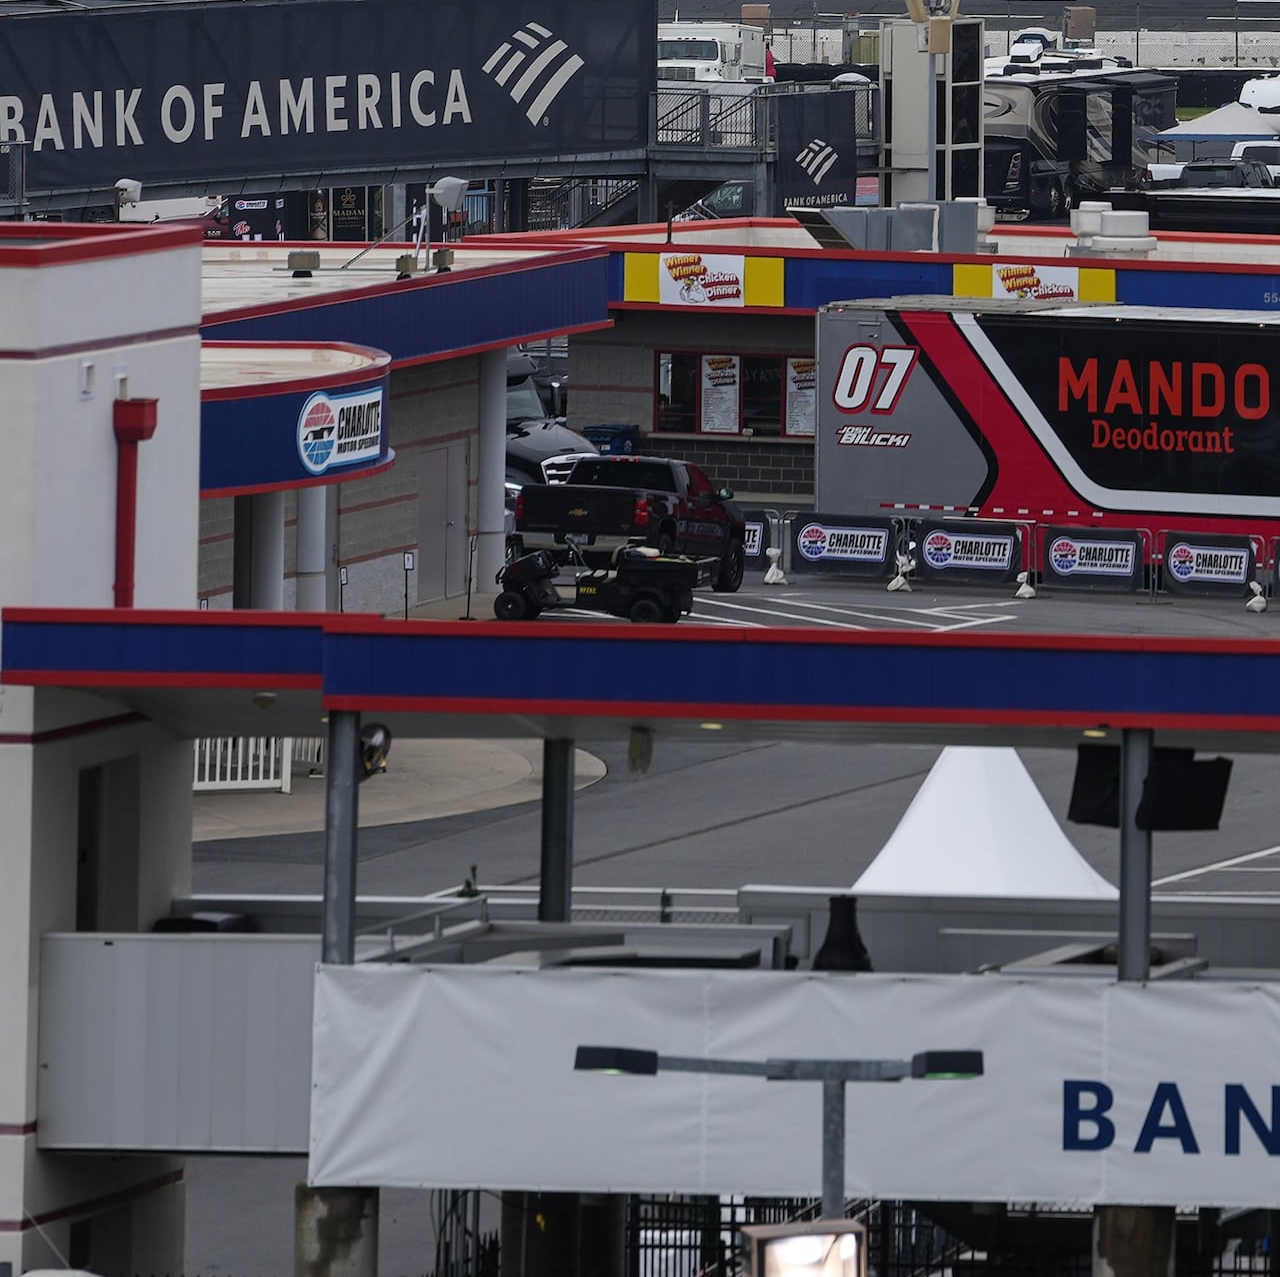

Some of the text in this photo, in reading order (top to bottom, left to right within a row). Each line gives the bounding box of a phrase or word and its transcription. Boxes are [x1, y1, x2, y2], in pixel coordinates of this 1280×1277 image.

[0, 69, 472, 152] BANK OF AMERICA
[784, 193, 848, 207] BANK OF AMERICA
[664, 255, 700, 268] Winner
[669, 265, 706, 280] Winner
[698, 272, 737, 286] Chicken
[998, 266, 1034, 279] Winner
[1003, 276, 1038, 290] Winner
[1031, 283, 1071, 296] Chicken
[706, 286, 739, 298] Dinner
[833, 344, 919, 413] 07
[1058, 357, 1270, 419] MANDO
[337, 401, 380, 440] CHARLOTTE
[840, 433, 910, 447] BILICKI
[1092, 420, 1235, 454] Deodorant
[828, 533, 882, 550] CHARLOTTE
[953, 540, 1007, 557] CHARLOTTE
[1079, 546, 1130, 563] CHARLOTTE
[1196, 553, 1243, 570] CHARLOTTE
